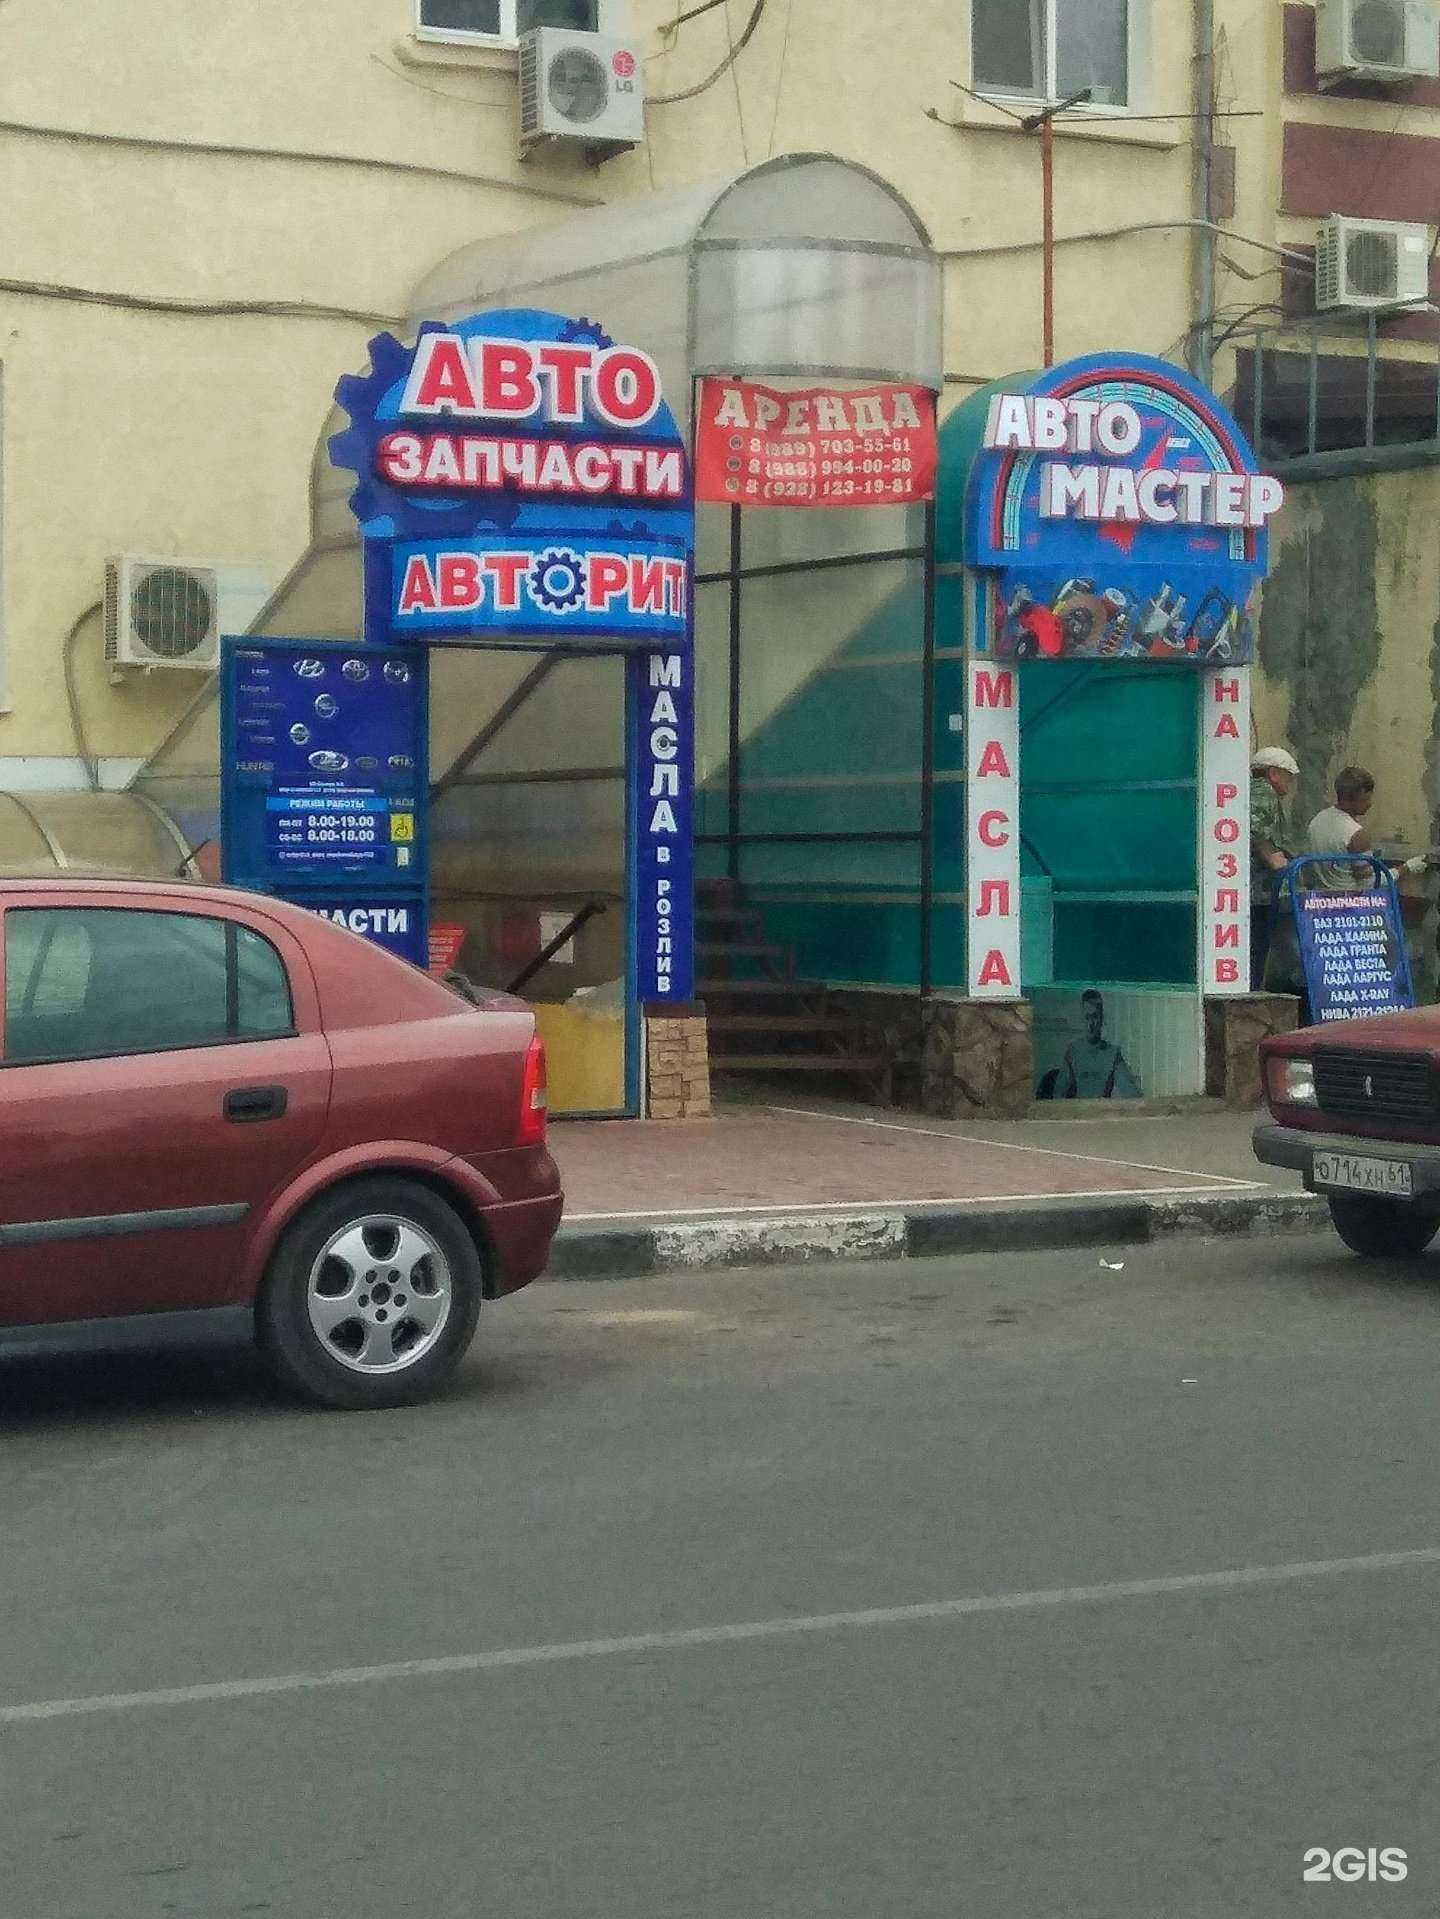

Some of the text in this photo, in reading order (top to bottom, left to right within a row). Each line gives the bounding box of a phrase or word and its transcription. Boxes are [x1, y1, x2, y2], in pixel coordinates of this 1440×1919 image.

[616, 80, 633, 93] LG
[400, 332, 662, 427] АВТО
[714, 389, 921, 437] АРЕНДА
[983, 393, 1141, 455] АВТО
[386, 435, 684, 495] ЗАПЧАСТИ
[1039, 462, 1284, 527] МАСТЕР
[649, 654, 682, 992] МАСЛА В РОЗЛИВ
[974, 671, 1013, 986] МАСЛА
[1213, 678, 1239, 983] НА РОЗЛИВ
[312, 908, 408, 934] АСТИ
[1313, 917, 1333, 929] ВАЗ
[1314, 929, 1388, 944] ЛАДА КАЛИНА
[1320, 943, 1387, 959] ЛАДА ГРАНТА
[1324, 958, 1387, 973] ЛАДА ВЕСТА
[1323, 974, 1352, 986] ЛАДА
[1330, 990, 1359, 1003] ЛАДА
